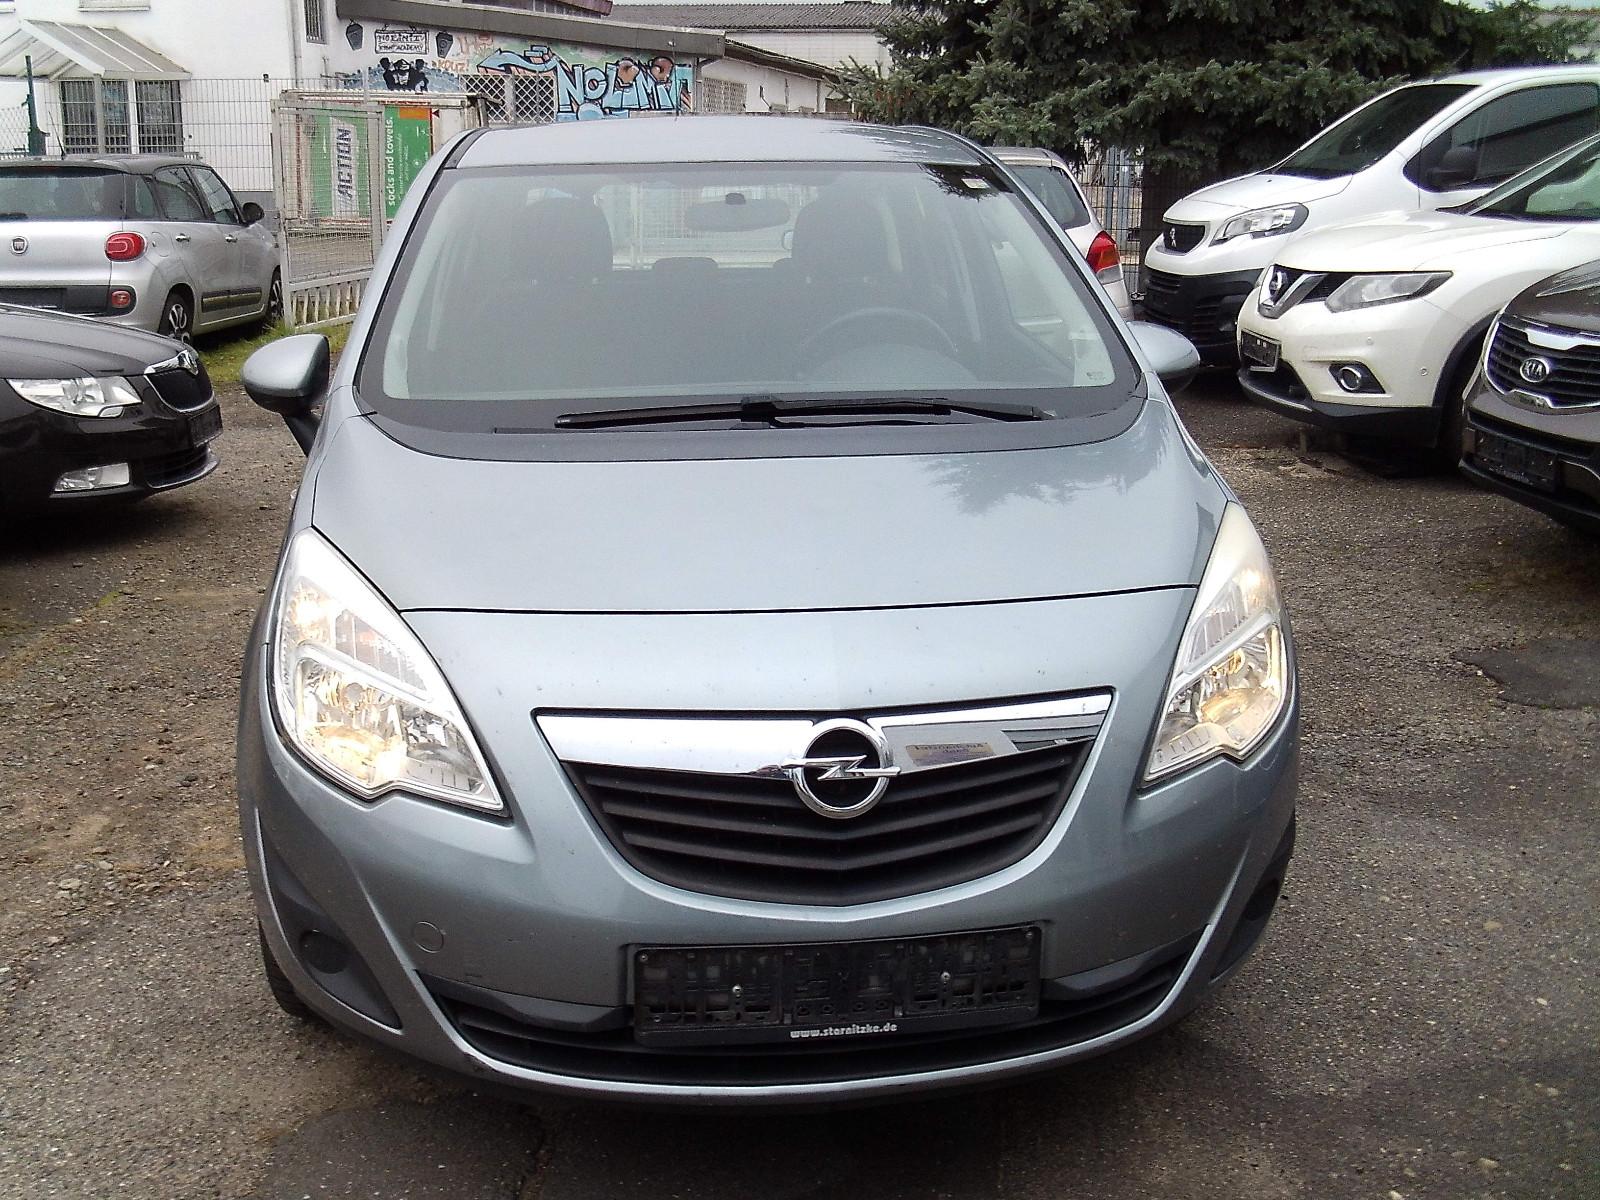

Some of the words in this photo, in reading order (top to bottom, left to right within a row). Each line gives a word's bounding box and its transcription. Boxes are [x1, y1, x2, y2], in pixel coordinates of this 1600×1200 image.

[336, 128, 352, 200] ACTION
[386, 156, 394, 174] and
[386, 175, 395, 206] socks
